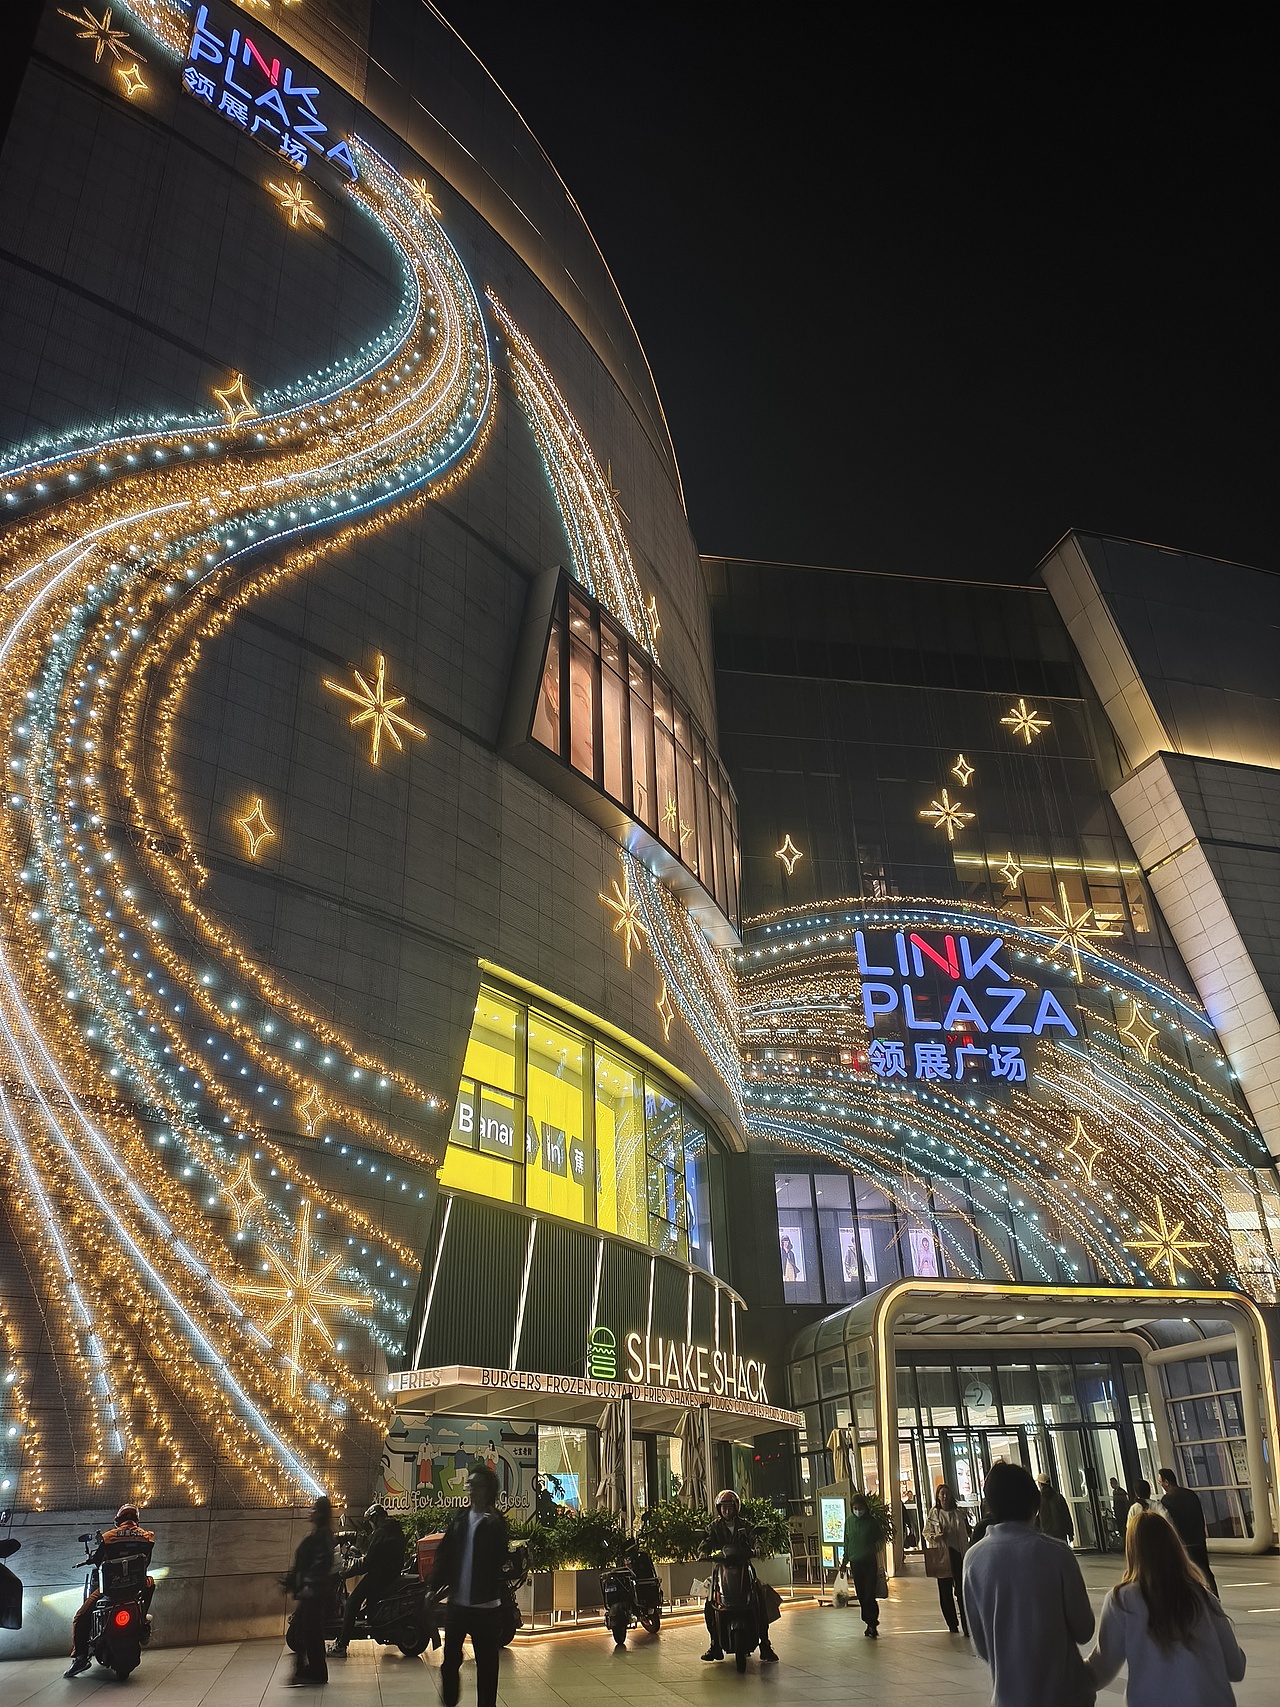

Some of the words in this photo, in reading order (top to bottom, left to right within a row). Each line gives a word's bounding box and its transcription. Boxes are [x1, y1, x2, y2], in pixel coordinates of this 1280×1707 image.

[196, 5, 320, 115] LINK
[184, 66, 308, 167] 领展广场
[190, 33, 358, 181] PLAZA
[854, 930, 1011, 982] LINK
[861, 982, 1078, 1037] PLAZA
[868, 1039, 1027, 1081] 领展广场
[400, 1370, 441, 1390] FRIES
[481, 1369, 541, 1391] BURGERS
[546, 1375, 592, 1395] FROZEN
[596, 1381, 641, 1400] CUSTARD
[644, 1386, 667, 1403] FRIES
[669, 1389, 698, 1407] SHAKES
[626, 1332, 710, 1393] SHAKE
[712, 1350, 769, 1404] SHACK
[973, 1387, 985, 1407] 2
[499, 1493, 531, 1512] Good
